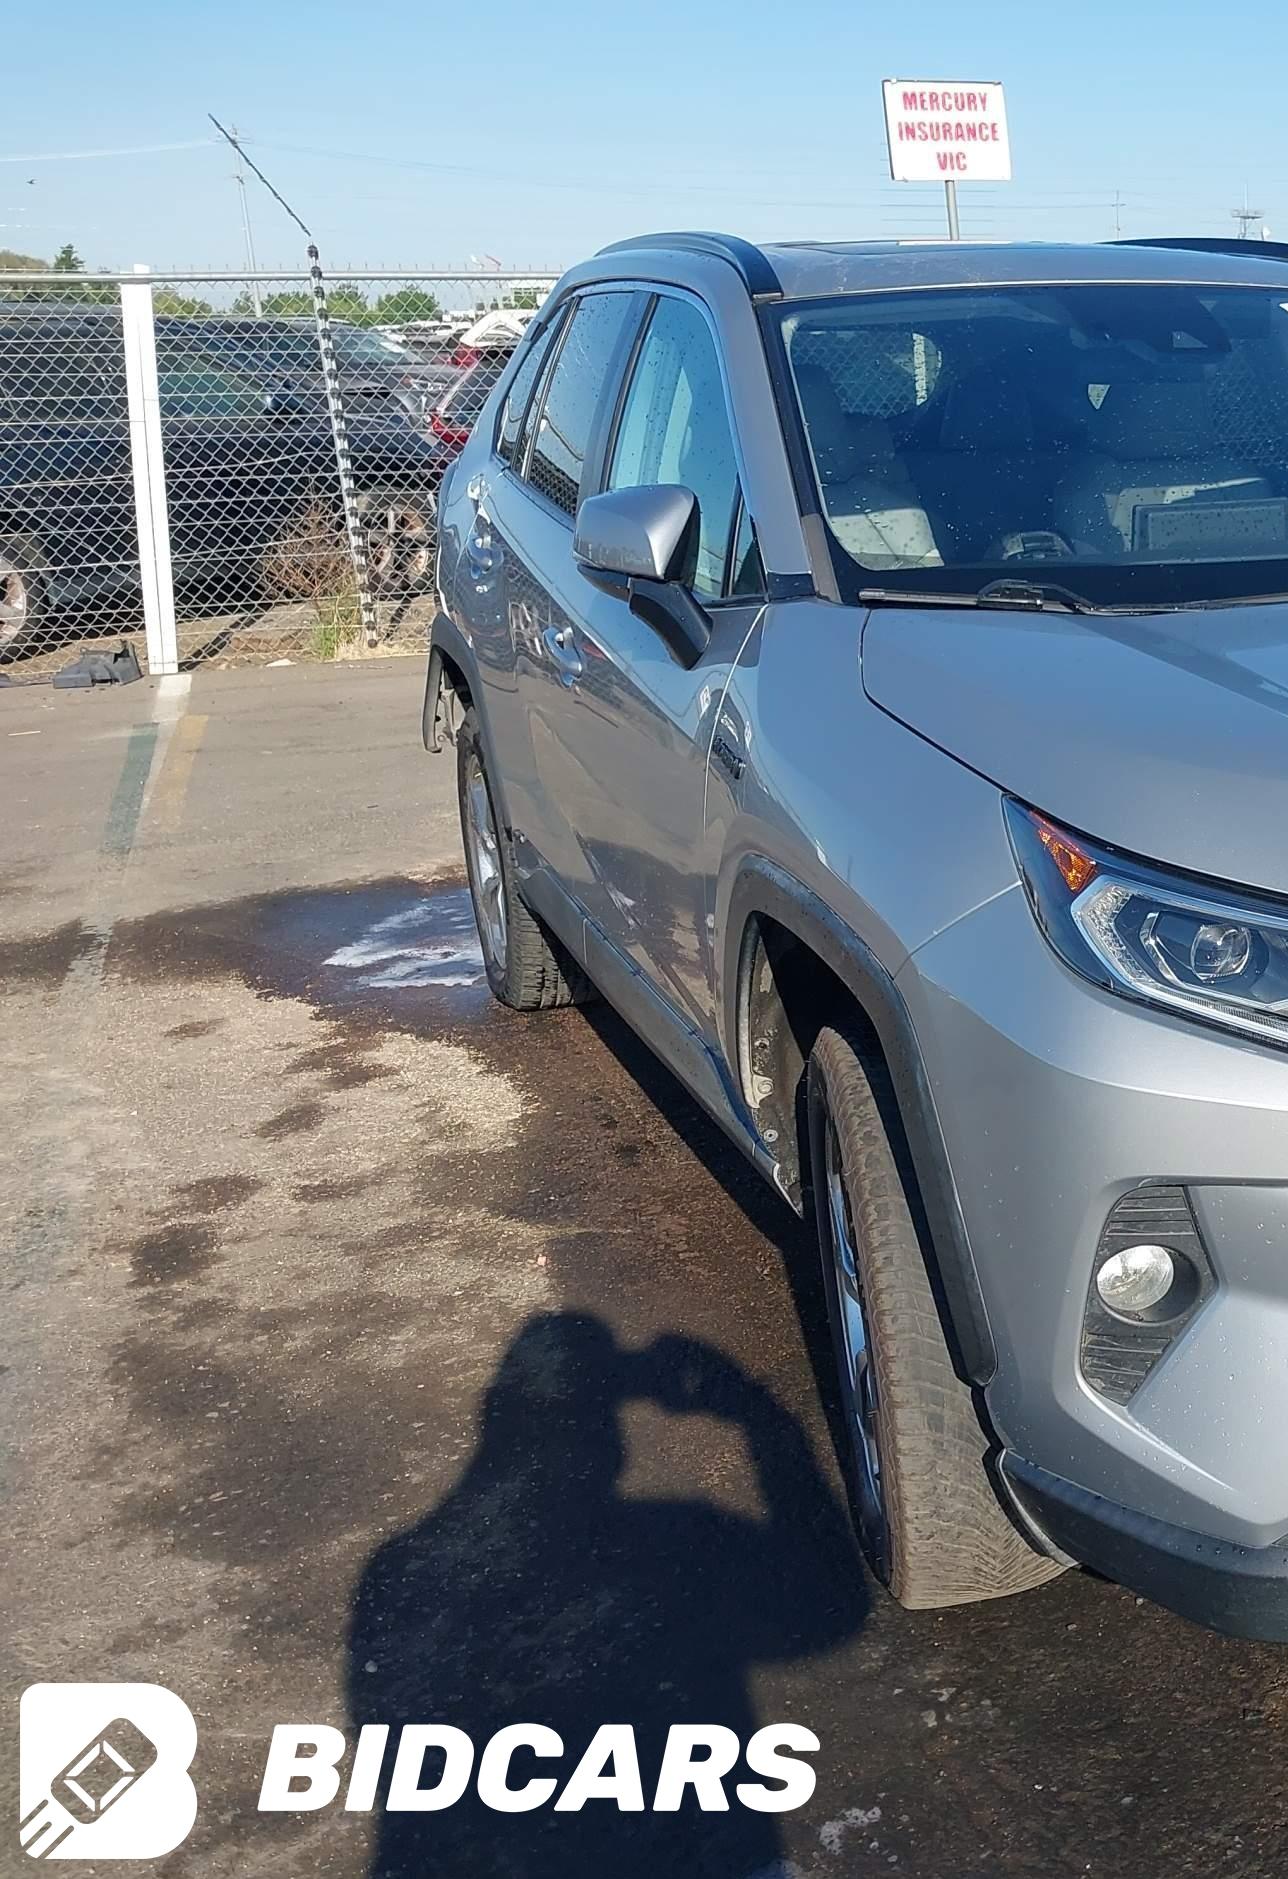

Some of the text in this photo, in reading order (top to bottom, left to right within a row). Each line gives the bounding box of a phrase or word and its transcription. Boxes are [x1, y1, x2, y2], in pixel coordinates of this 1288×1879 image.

[902, 91, 988, 112] MERCURY
[898, 121, 1000, 142] INSURANCE
[936, 152, 967, 171] VIC
